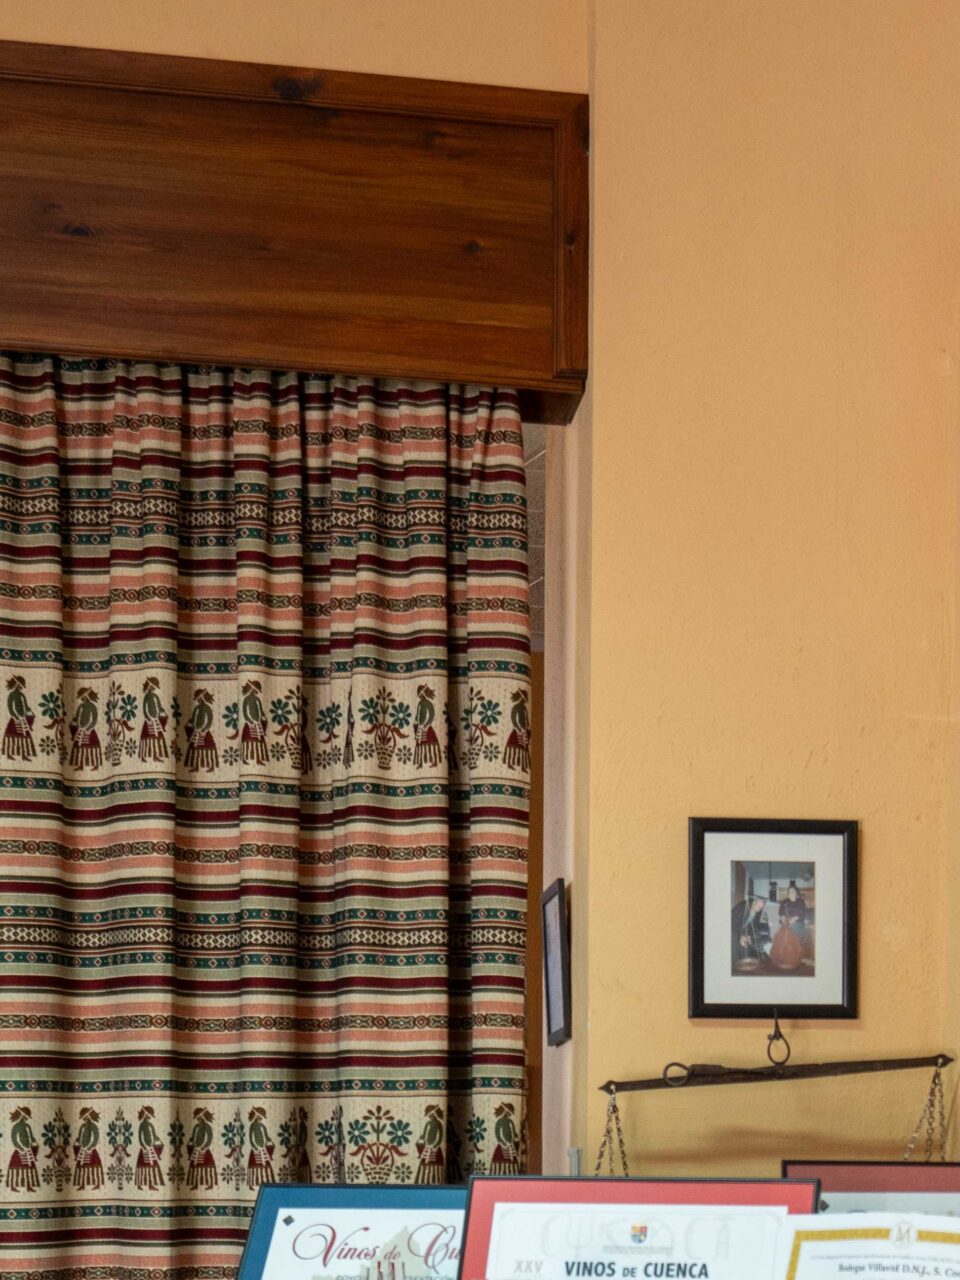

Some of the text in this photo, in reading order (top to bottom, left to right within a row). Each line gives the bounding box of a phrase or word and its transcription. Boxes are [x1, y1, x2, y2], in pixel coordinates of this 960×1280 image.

[292, 1223, 379, 1268] Vinos
[383, 1245, 401, 1260] de
[564, 1261, 709, 1279] VINOS DE CUENCA
